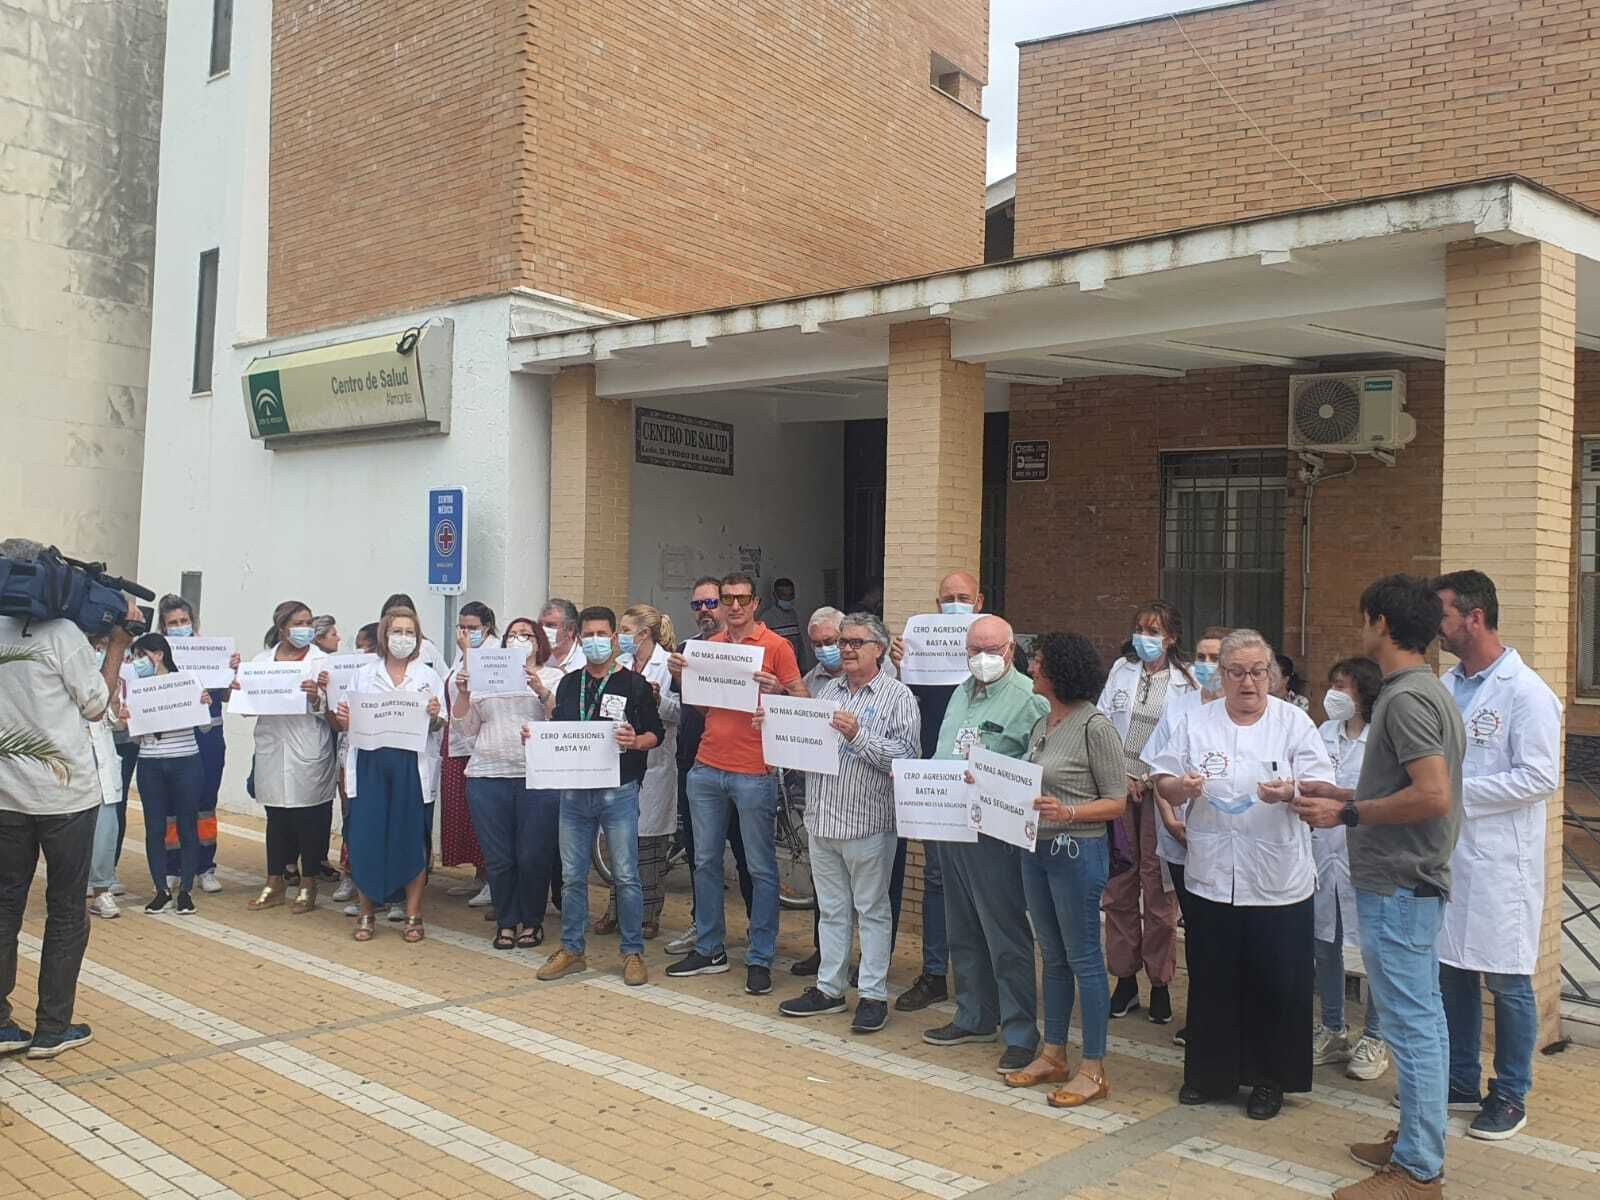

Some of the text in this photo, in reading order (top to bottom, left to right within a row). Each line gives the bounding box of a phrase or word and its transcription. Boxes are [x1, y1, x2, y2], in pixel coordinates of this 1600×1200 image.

[331, 366, 409, 395] Centro de Salud
[642, 421, 728, 452] CENTRO DE SALUD
[913, 626, 968, 634] CERO AGRESION
[191, 644, 227, 652] AGRESIONES
[926, 639, 961, 647] BASTA YA!
[691, 650, 753, 663] NO MAS AGRESIONES
[186, 663, 220, 671] SEGURIDAD
[267, 668, 302, 676] AGRESIONES
[143, 686, 157, 694] MAS
[158, 679, 196, 691] AGRESIONES
[698, 675, 746, 687] MAS SEGURIDAD
[142, 700, 192, 714] MAS SEGURIDAD
[360, 699, 419, 709] CERO AGRESIONES
[374, 710, 392, 719] BASTA
[769, 706, 831, 719] NO MAS AGRESIONES
[540, 732, 605, 740] CERO AGRESIONES
[775, 734, 823, 746] MAS SEGURIDAD
[904, 771, 962, 782] CERO AGRESIONES
[974, 761, 1033, 787] NO MAS AGRESIONES
[915, 786, 948, 796] BASTA YA!
[979, 794, 1025, 816] MAS SEGURIDAD
